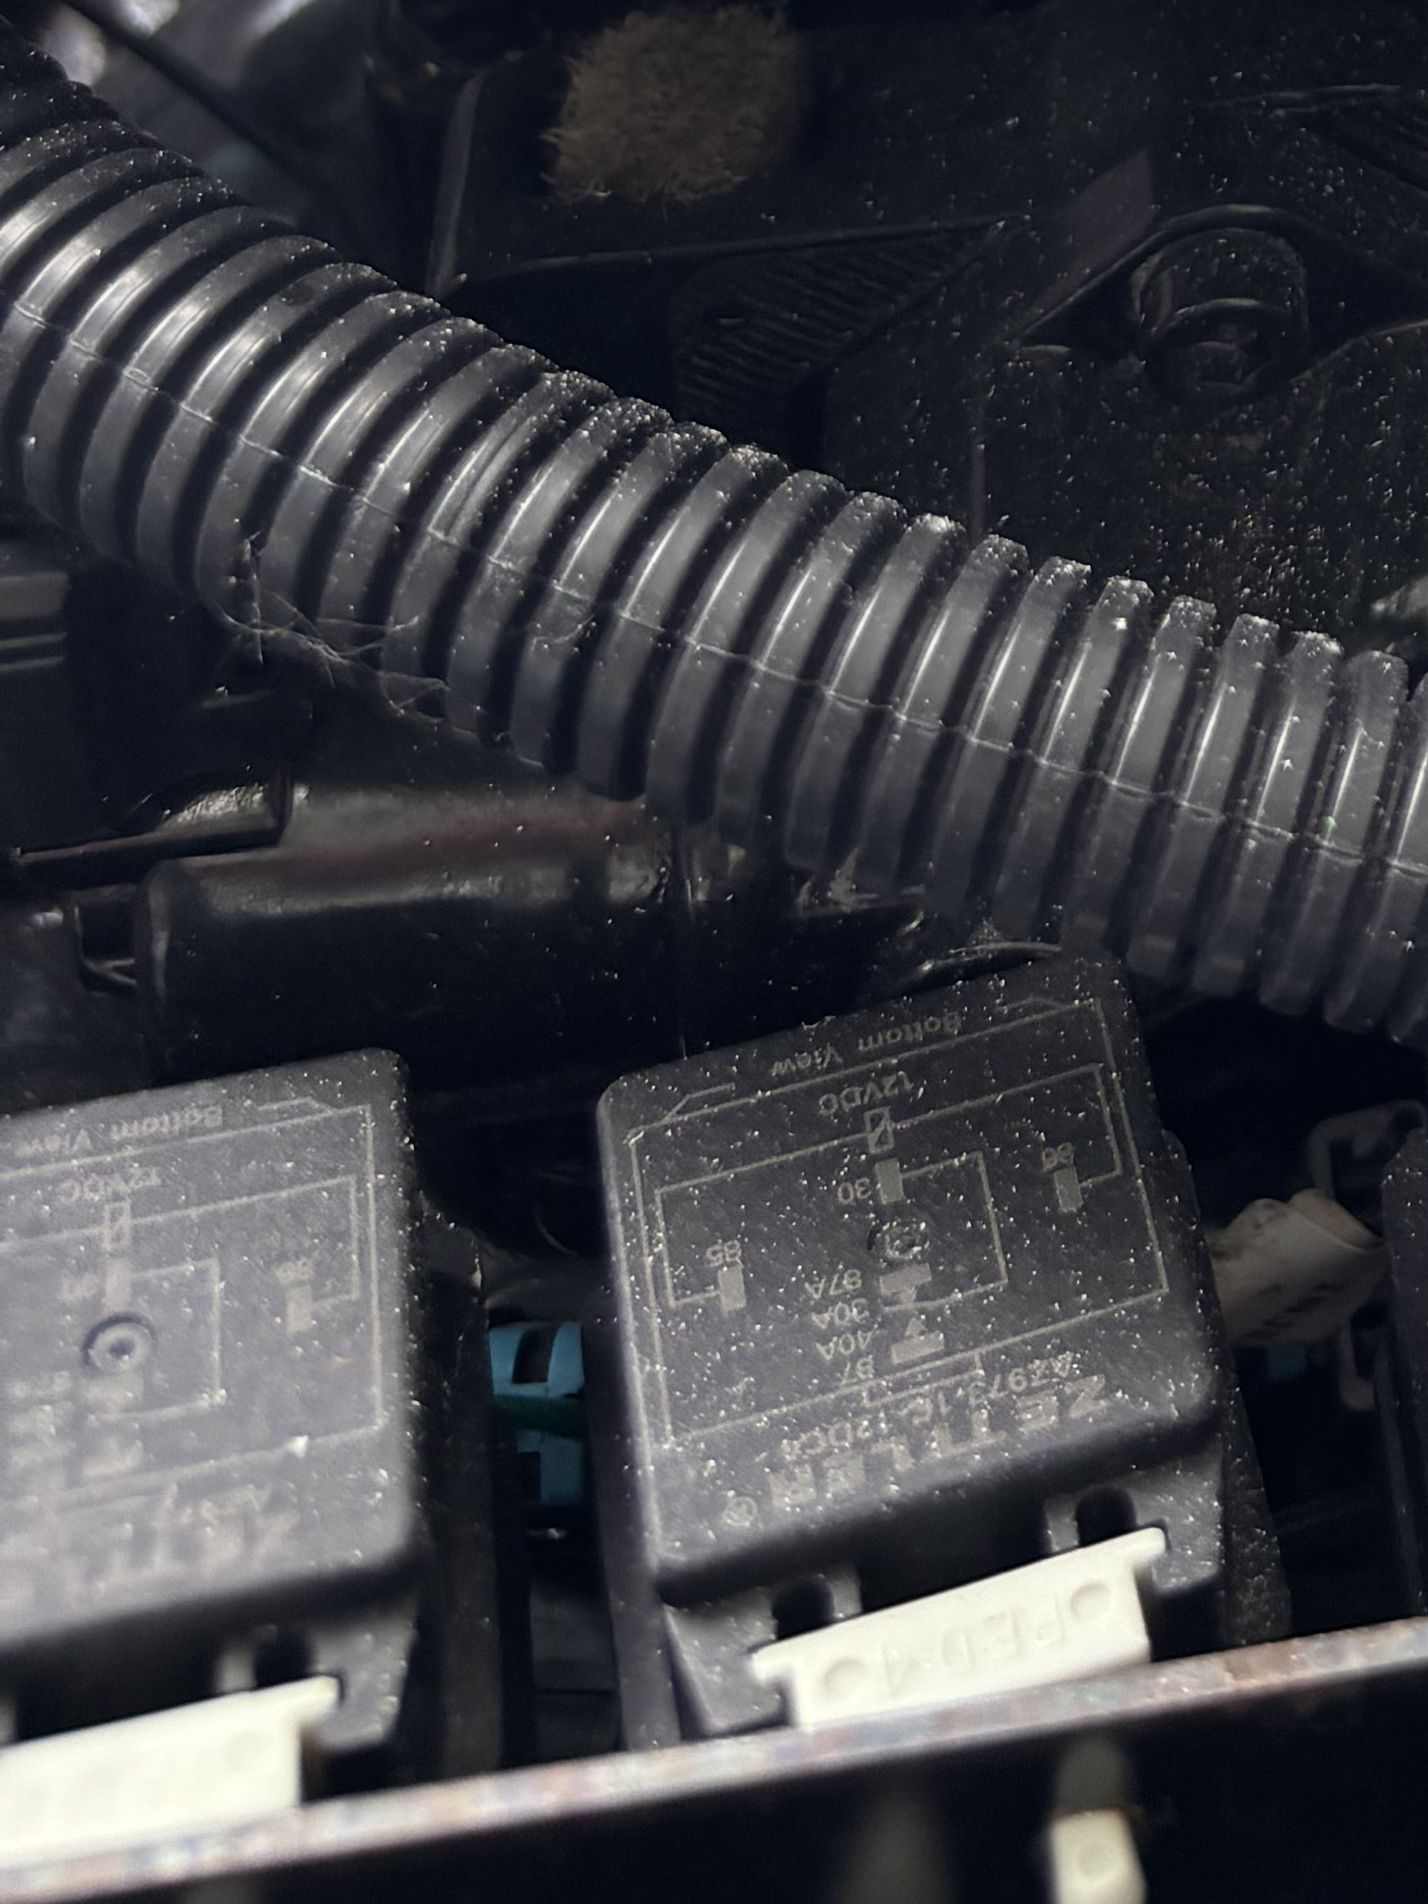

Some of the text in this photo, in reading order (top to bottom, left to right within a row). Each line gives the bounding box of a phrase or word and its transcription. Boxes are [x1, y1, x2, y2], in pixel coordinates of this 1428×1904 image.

[770, 1010, 963, 1080] Bottom View
[836, 1181, 872, 1205] 30
[805, 1268, 863, 1300] 87A
[814, 1329, 873, 1361] 40A
